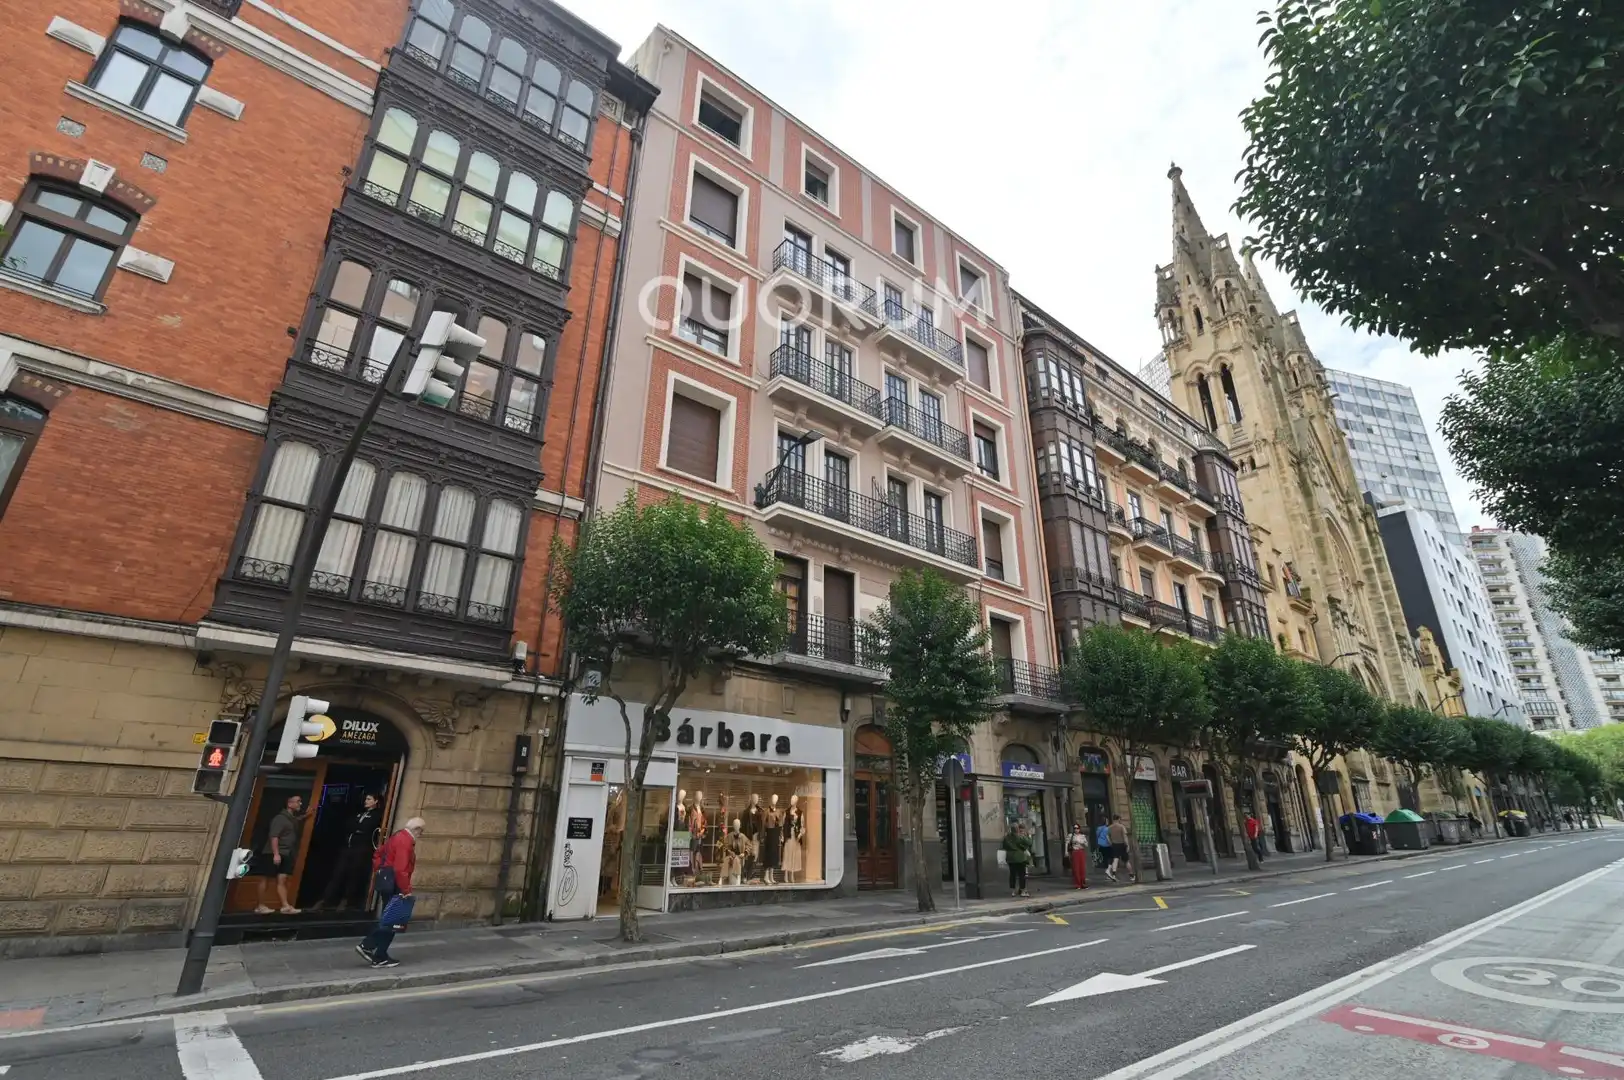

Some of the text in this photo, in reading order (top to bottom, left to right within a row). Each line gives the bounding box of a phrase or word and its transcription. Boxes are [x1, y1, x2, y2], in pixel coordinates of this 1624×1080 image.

[342, 719, 380, 733] DILUX
[651, 710, 791, 754] Bárbara
[341, 730, 376, 741] AMEZAGA
[1171, 764, 1188, 777] BAR
[1484, 966, 1624, 998] 30
